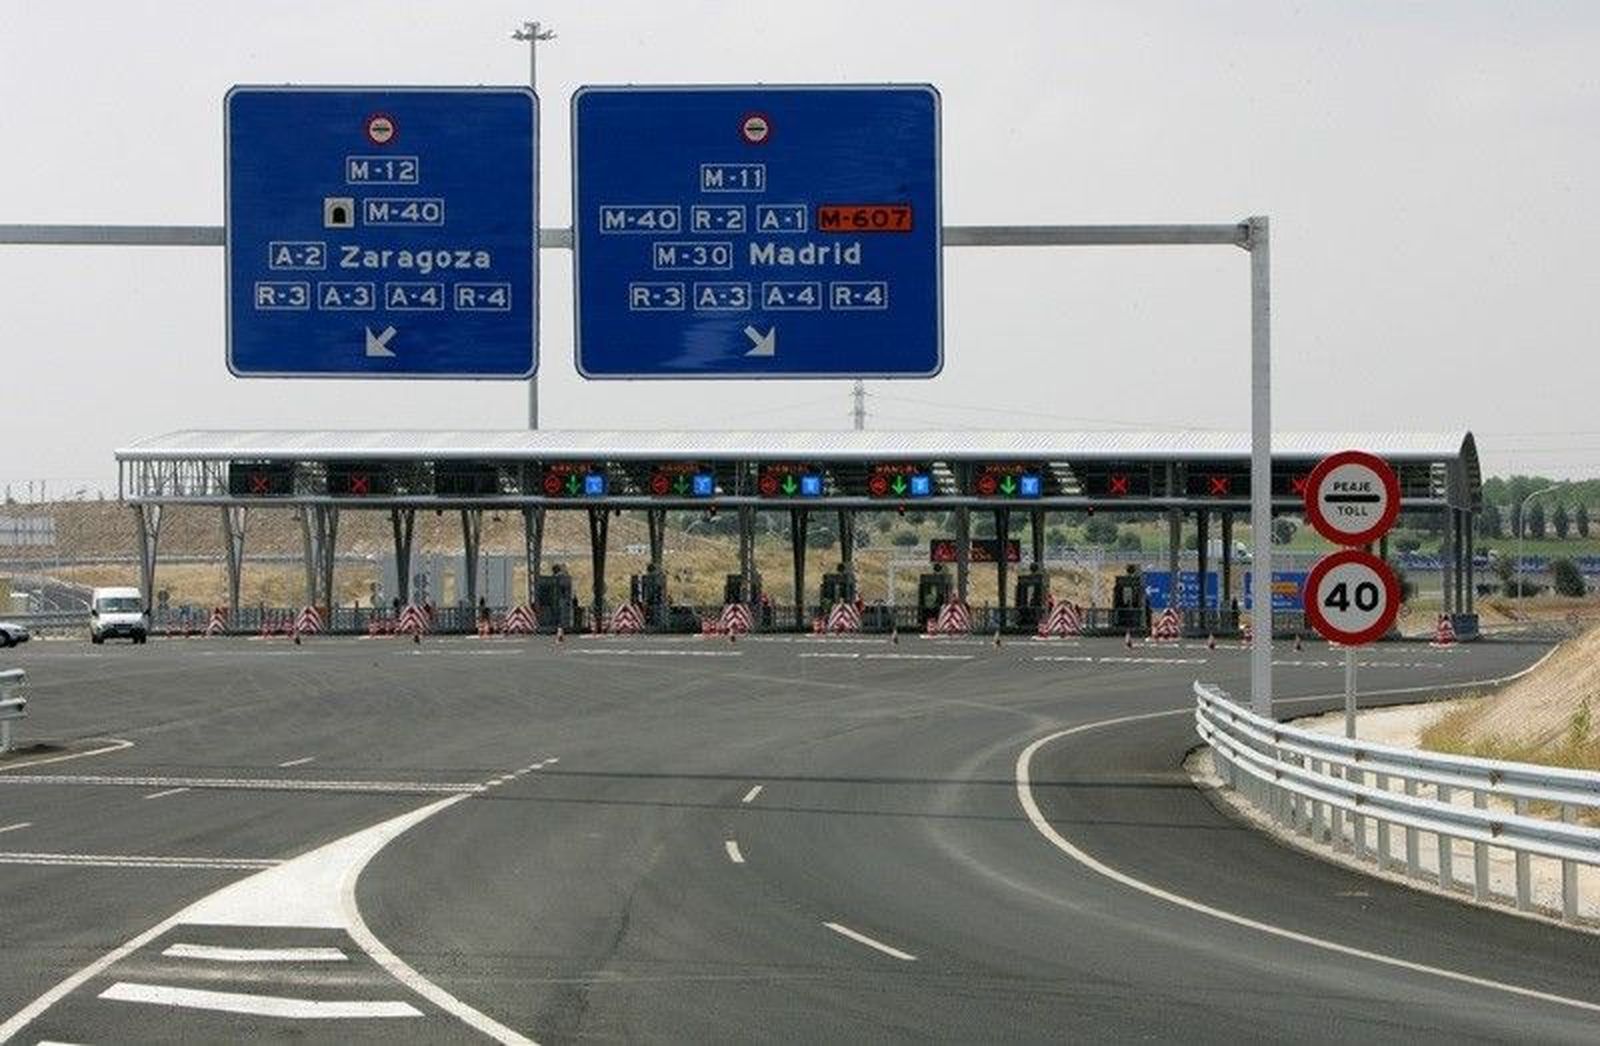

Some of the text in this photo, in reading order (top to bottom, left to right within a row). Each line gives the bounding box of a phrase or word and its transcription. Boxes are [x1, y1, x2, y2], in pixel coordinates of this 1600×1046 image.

[351, 160, 415, 180] M-12
[705, 168, 762, 187] M-11
[368, 202, 440, 221] M-40
[604, 209, 909, 229] M-40 R-2 A-1 M-607
[275, 245, 491, 273] A-2 Zaragoza
[657, 242, 862, 265] M-30 Madrid
[257, 286, 507, 306] R-3 A-3 A-4 R-4
[633, 286, 884, 306] R-3 A-3 A-4 R-4
[1333, 481, 1371, 492] PEAJE
[1337, 506, 1368, 516] TOLL
[1324, 581, 1379, 612] 40
